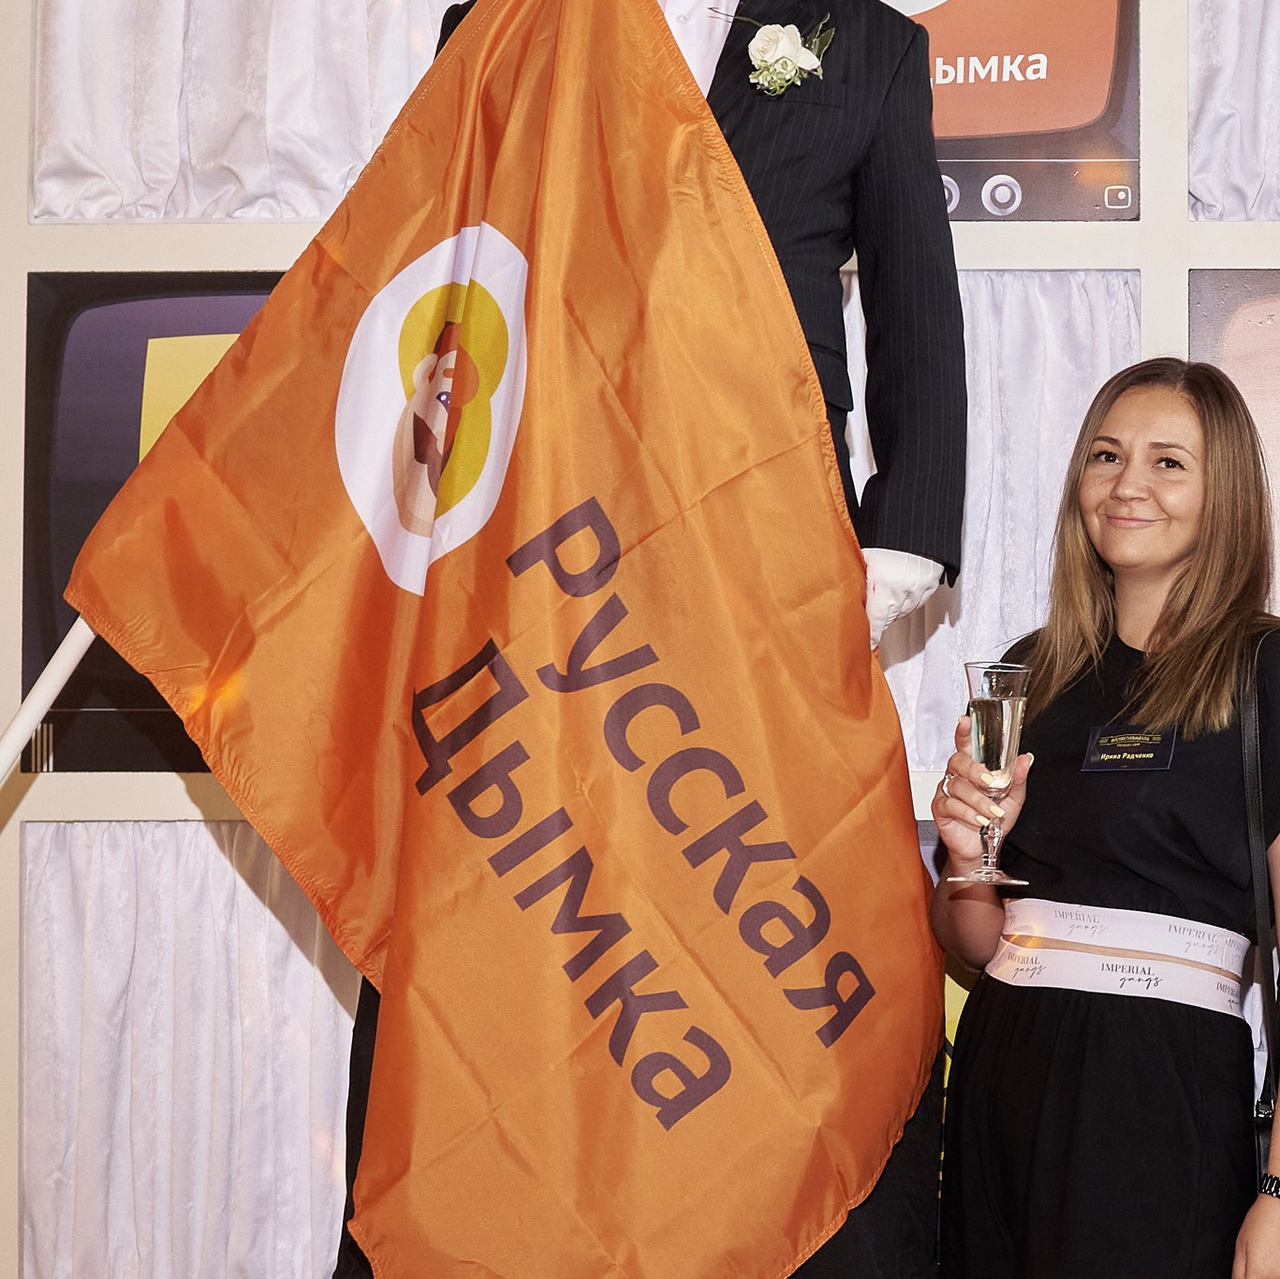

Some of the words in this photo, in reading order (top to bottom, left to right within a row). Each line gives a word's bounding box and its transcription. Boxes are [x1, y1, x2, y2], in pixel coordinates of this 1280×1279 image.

[930, 53, 1048, 89] ымка
[505, 496, 876, 1048] Русская
[411, 638, 732, 1131] Дымка
[1054, 910, 1100, 923] IMPERIAL
[1168, 924, 1218, 944] IMPERIAL
[1101, 963, 1155, 976] IMPERIAL
[1119, 976, 1163, 990] gangs
